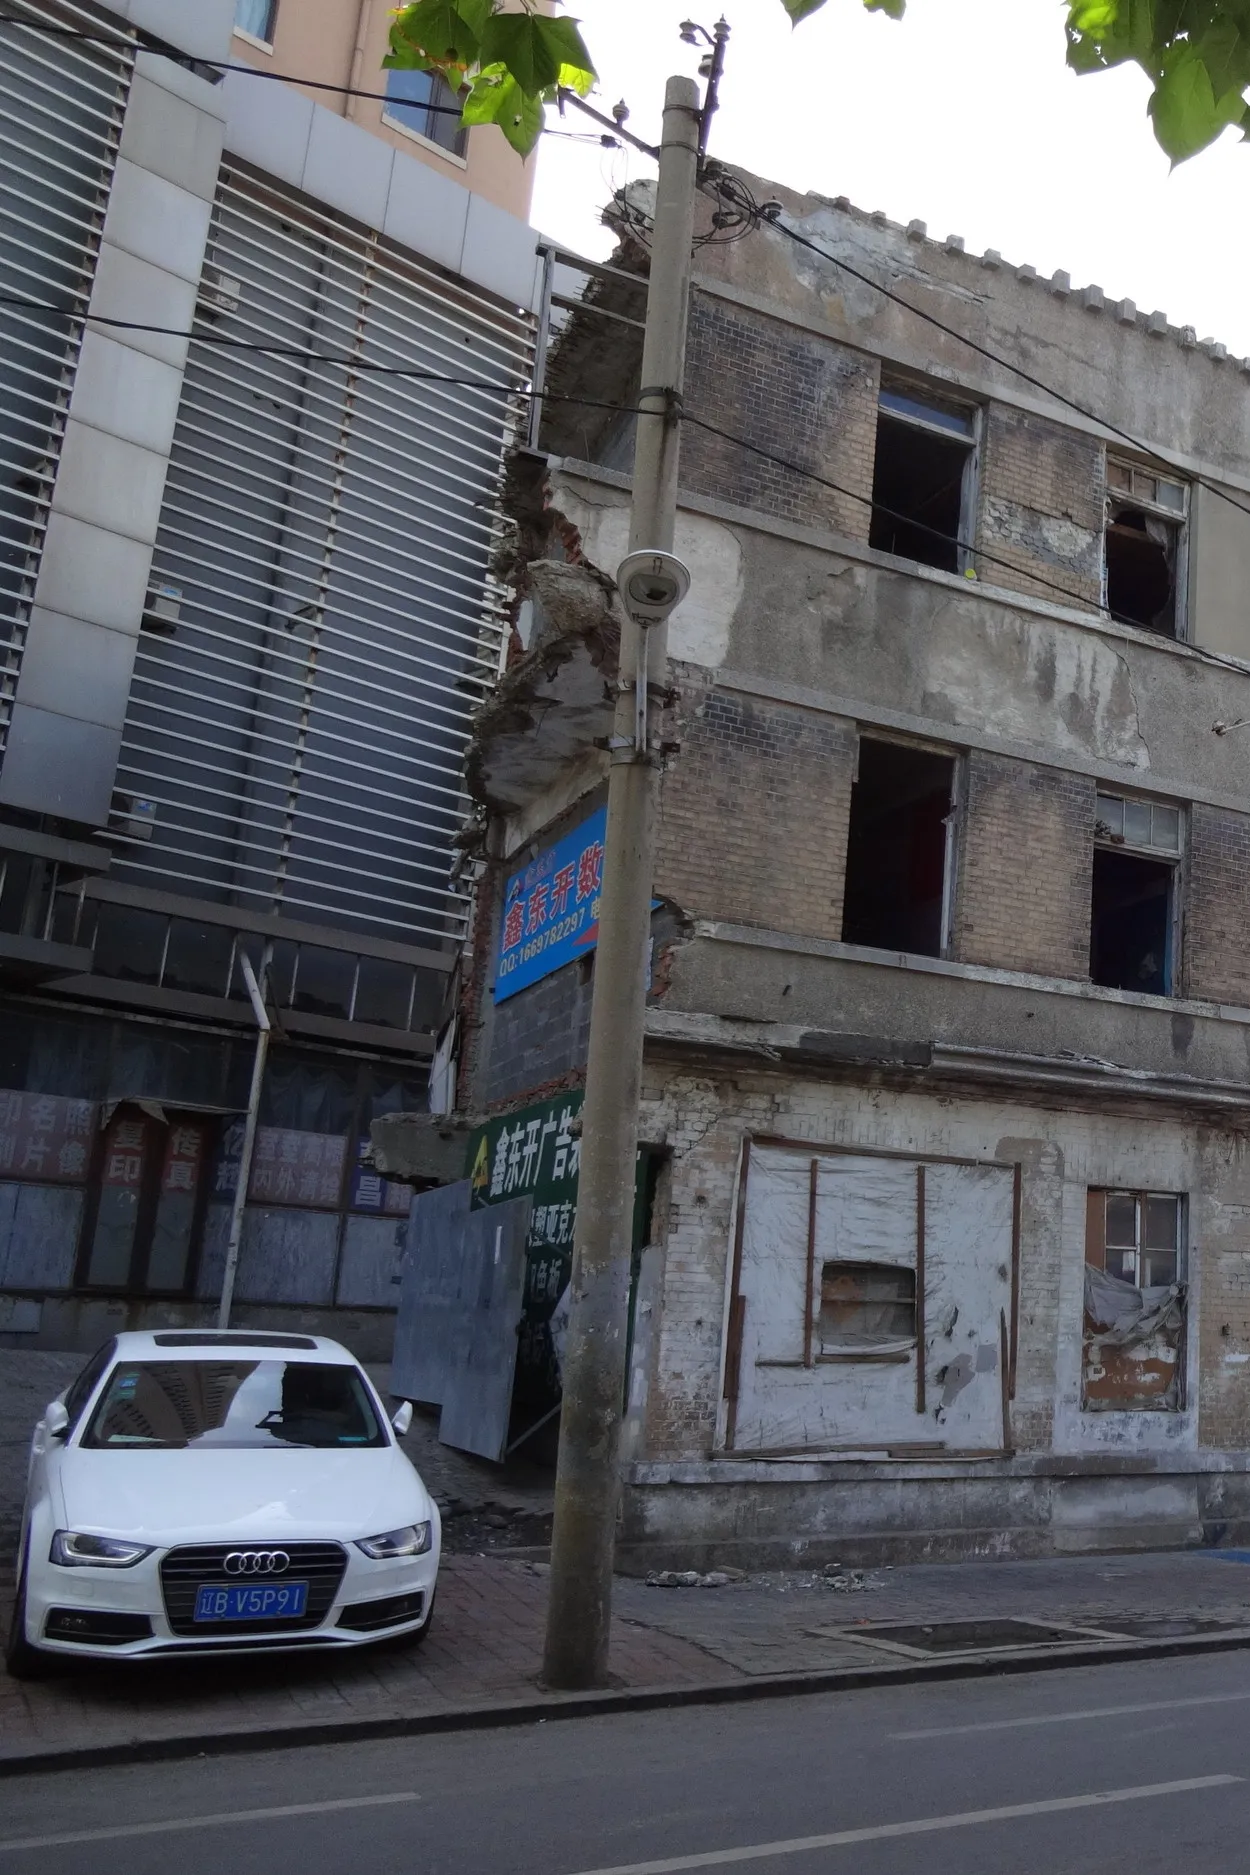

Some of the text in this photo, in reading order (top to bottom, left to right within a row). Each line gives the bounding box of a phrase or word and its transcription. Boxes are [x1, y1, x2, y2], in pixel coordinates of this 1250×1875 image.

[502, 840, 604, 954] 鑫东开数
[499, 906, 586, 977] QQ:1669782297
[107, 1119, 146, 1183] 复印
[166, 1125, 201, 1190] 传真
